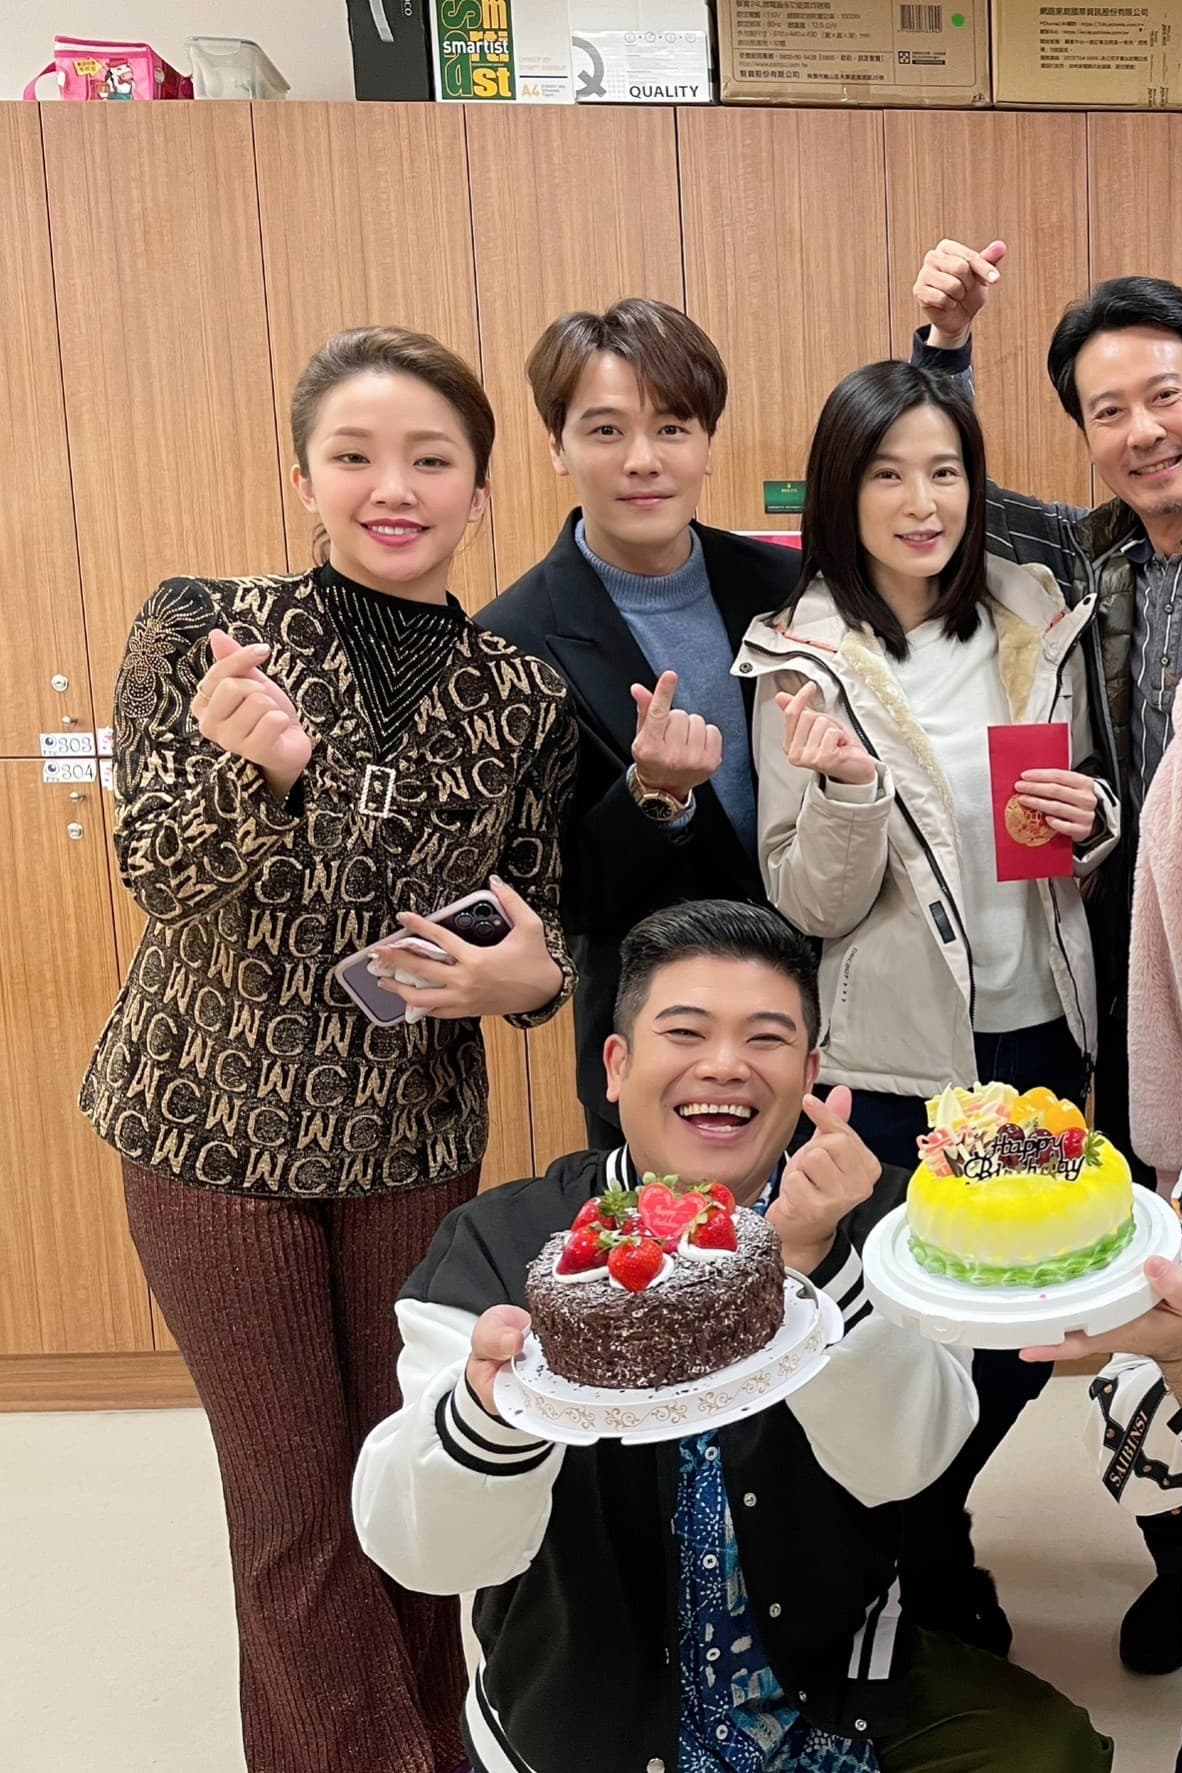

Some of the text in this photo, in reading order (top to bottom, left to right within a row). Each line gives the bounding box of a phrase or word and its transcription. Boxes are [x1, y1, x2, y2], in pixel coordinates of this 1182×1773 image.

[443, 40, 509, 54] smartist
[521, 84, 541, 97] A4
[629, 85, 699, 98] QUALITY
[58, 736, 92, 753] 303
[62, 763, 93, 780] 304
[993, 1133, 1065, 1161] Happy
[1109, 1411, 1148, 1488] SAIBINSI
